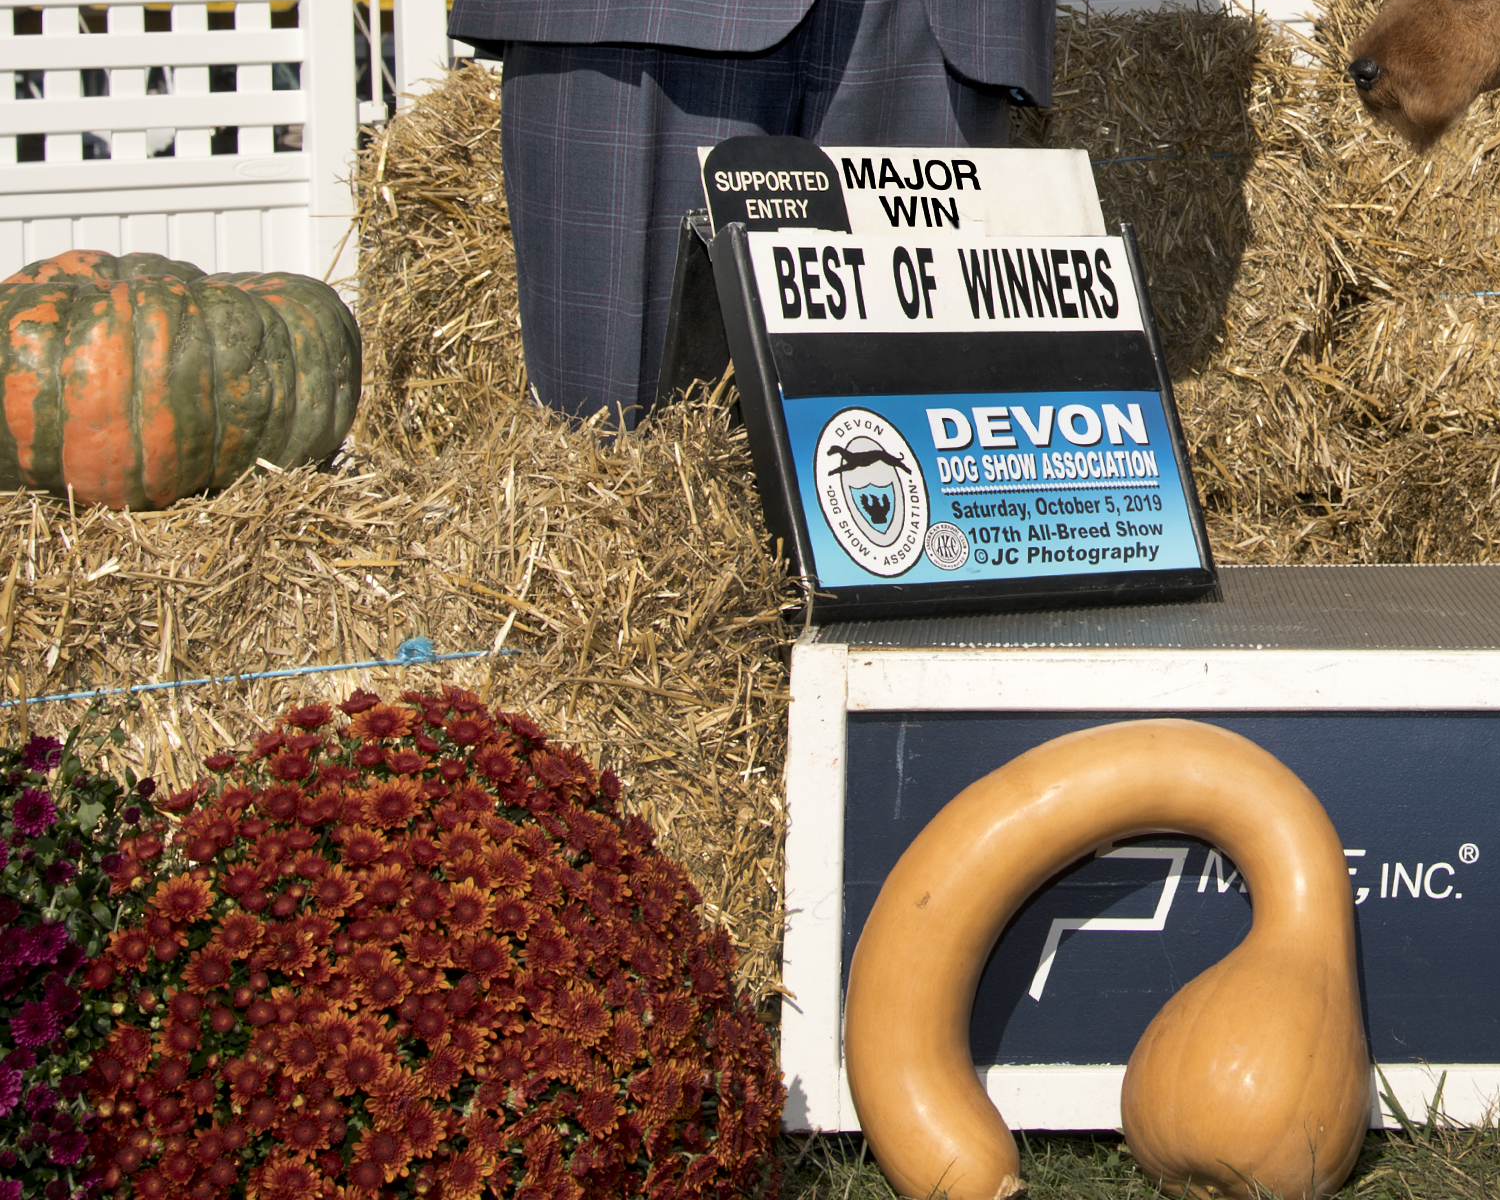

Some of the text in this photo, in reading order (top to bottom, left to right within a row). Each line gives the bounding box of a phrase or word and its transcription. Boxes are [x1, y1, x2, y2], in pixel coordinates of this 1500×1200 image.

[714, 171, 830, 192] SUPPORTED
[841, 157, 981, 191] MAJOR
[746, 198, 808, 219] ENTRY
[878, 196, 960, 229] WIN
[772, 246, 1119, 320] BEST OF WINNERS
[835, 418, 884, 438] DEVON
[926, 404, 1150, 451] DEVON
[936, 450, 1160, 484] DOG SHOW ASSOCIATION
[951, 494, 1163, 521] Saturday, October 5, 2019
[827, 484, 920, 566] DOG SHOW ASSOCIATION
[968, 520, 1163, 545] 107th All-Breed Show
[937, 535, 957, 558] AKC
[1027, 541, 1160, 565] Photography
